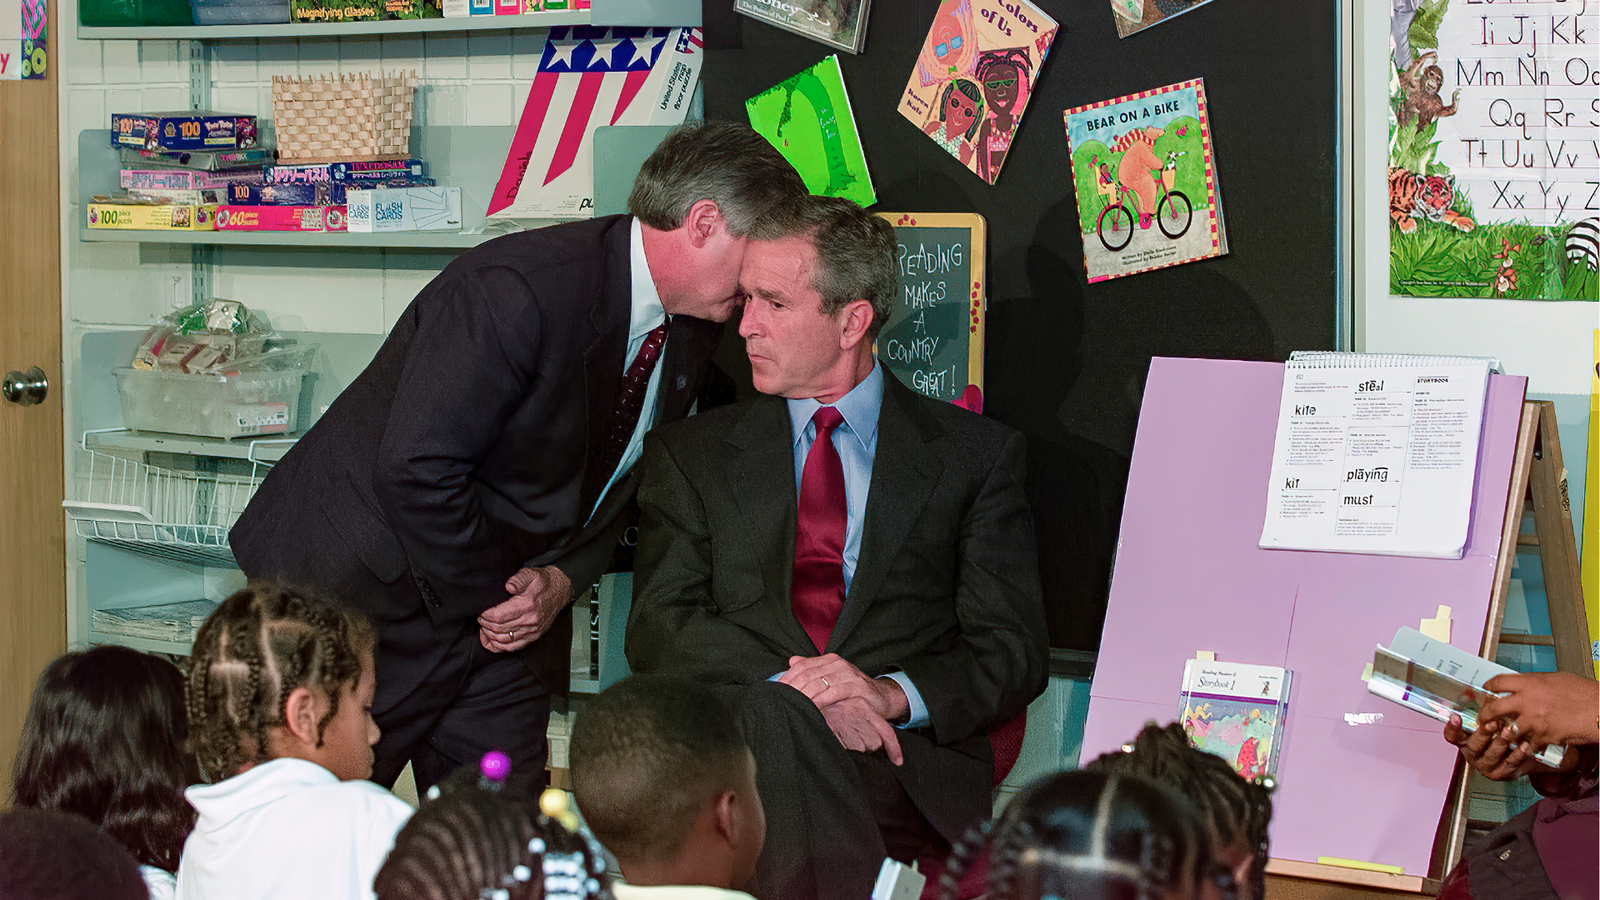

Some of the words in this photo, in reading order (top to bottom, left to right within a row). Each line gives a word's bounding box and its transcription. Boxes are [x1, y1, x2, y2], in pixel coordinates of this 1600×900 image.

[297, 7, 343, 20] Magnifying
[344, 7, 375, 18] Glasses
[981, 8, 998, 24] of
[998, 16, 1012, 37] Us
[1481, 16, 1494, 45] Ii
[1508, 16, 1536, 57] Jj
[1552, 16, 1586, 44] Kk
[678, 64, 687, 82] map
[1457, 58, 1504, 86] Mm
[1518, 57, 1550, 86] Nn
[660, 84, 674, 111] United
[668, 61, 682, 86] States
[674, 92, 684, 110] floor
[681, 67, 692, 93] puzzle
[906, 100, 922, 116] Katz
[908, 88, 929, 109] Karen
[1087, 115, 1115, 131] BEAR
[1119, 108, 1138, 124] ON
[1142, 108, 1150, 119] A
[1154, 100, 1180, 115] BIKE
[1489, 98, 1532, 140] Qq
[1544, 98, 1576, 127] Rr
[180, 121, 200, 136] 100
[1460, 139, 1487, 168] Tt
[1501, 139, 1533, 168] Uu
[1545, 139, 1578, 168] Vv
[234, 185, 250, 199] 100
[1492, 180, 1524, 209] Xx
[1539, 180, 1570, 224] Yy
[375, 211, 403, 221] CARDS
[376, 201, 403, 211] FLASH
[100, 210, 118, 225] 100
[229, 211, 245, 226] 60
[898, 243, 963, 277] READING
[904, 281, 947, 309] MAKES
[913, 310, 926, 334] A
[887, 336, 939, 366] COUNTRY
[1295, 404, 1317, 416] kite
[1285, 477, 1300, 489] kit
[1343, 494, 1374, 506] must
[1198, 676, 1229, 689] Storybook
